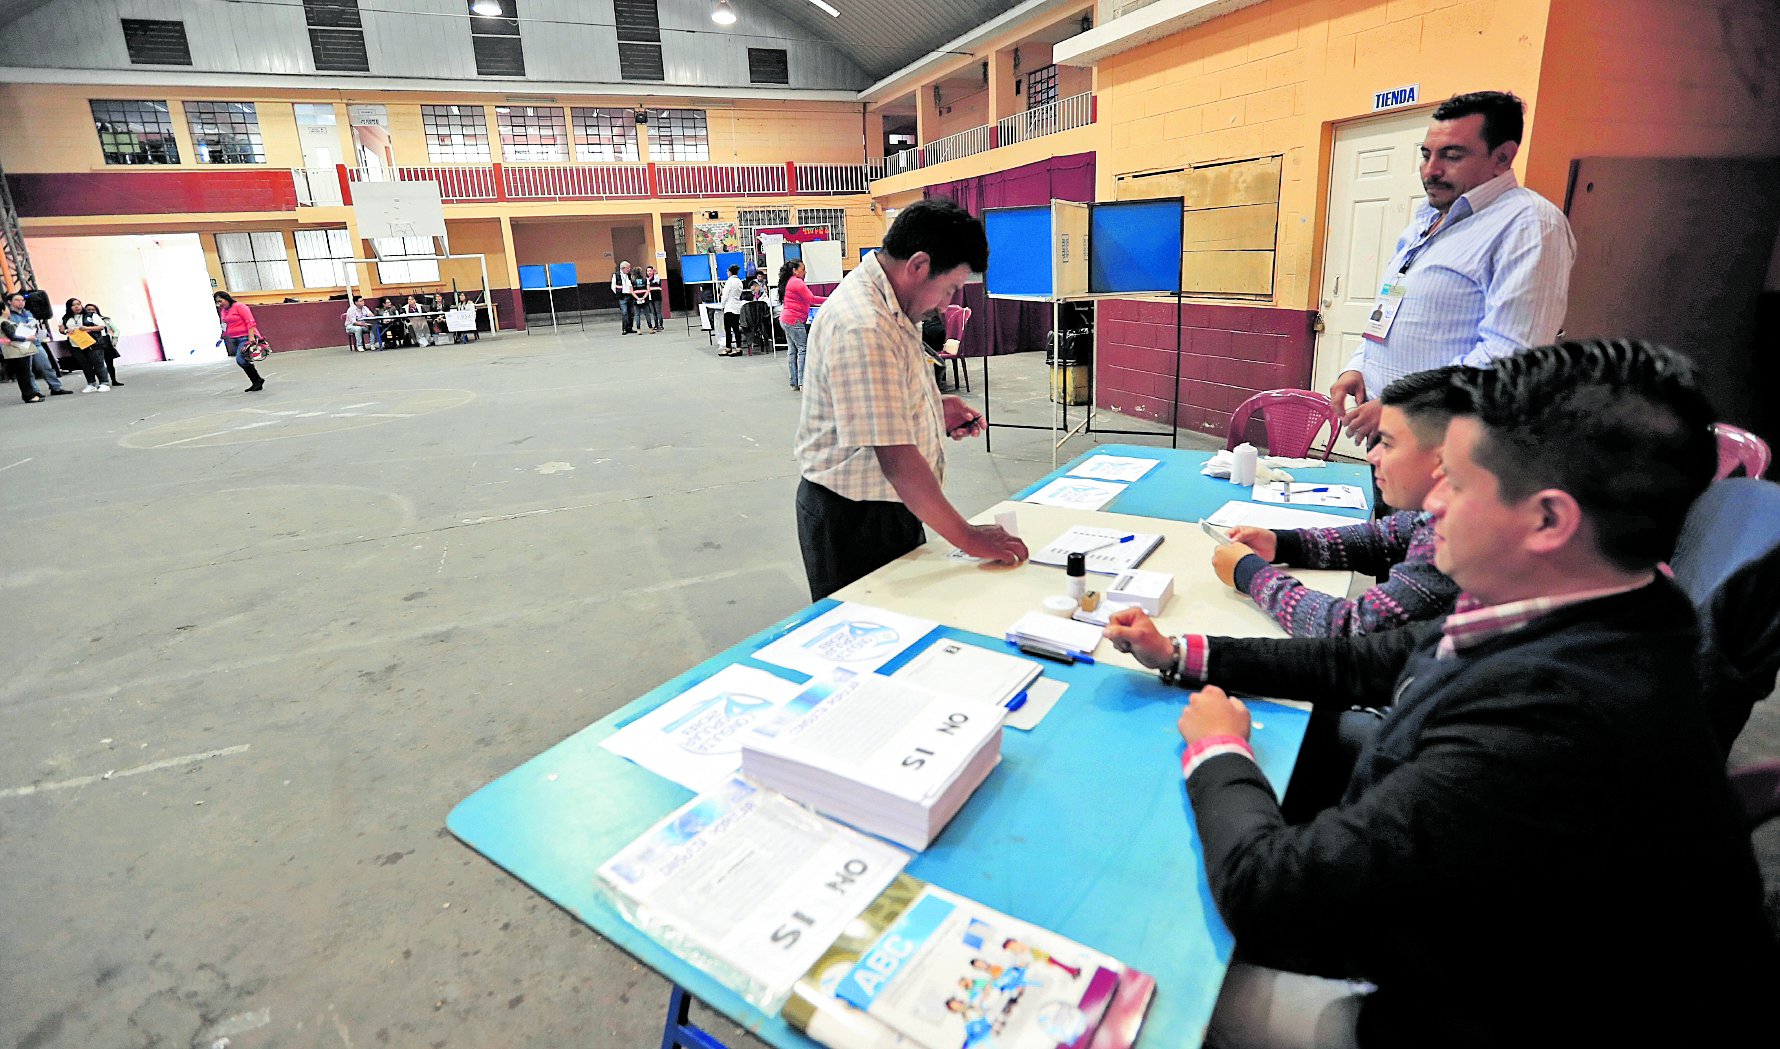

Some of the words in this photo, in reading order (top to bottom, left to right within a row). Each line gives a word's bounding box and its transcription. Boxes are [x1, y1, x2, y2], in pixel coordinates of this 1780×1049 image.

[1375, 86, 1415, 108] TIENDA
[901, 747, 936, 771] SI
[936, 712, 969, 735] NO
[770, 911, 816, 950] SI
[824, 859, 868, 895] NO
[853, 934, 914, 997] ABC
